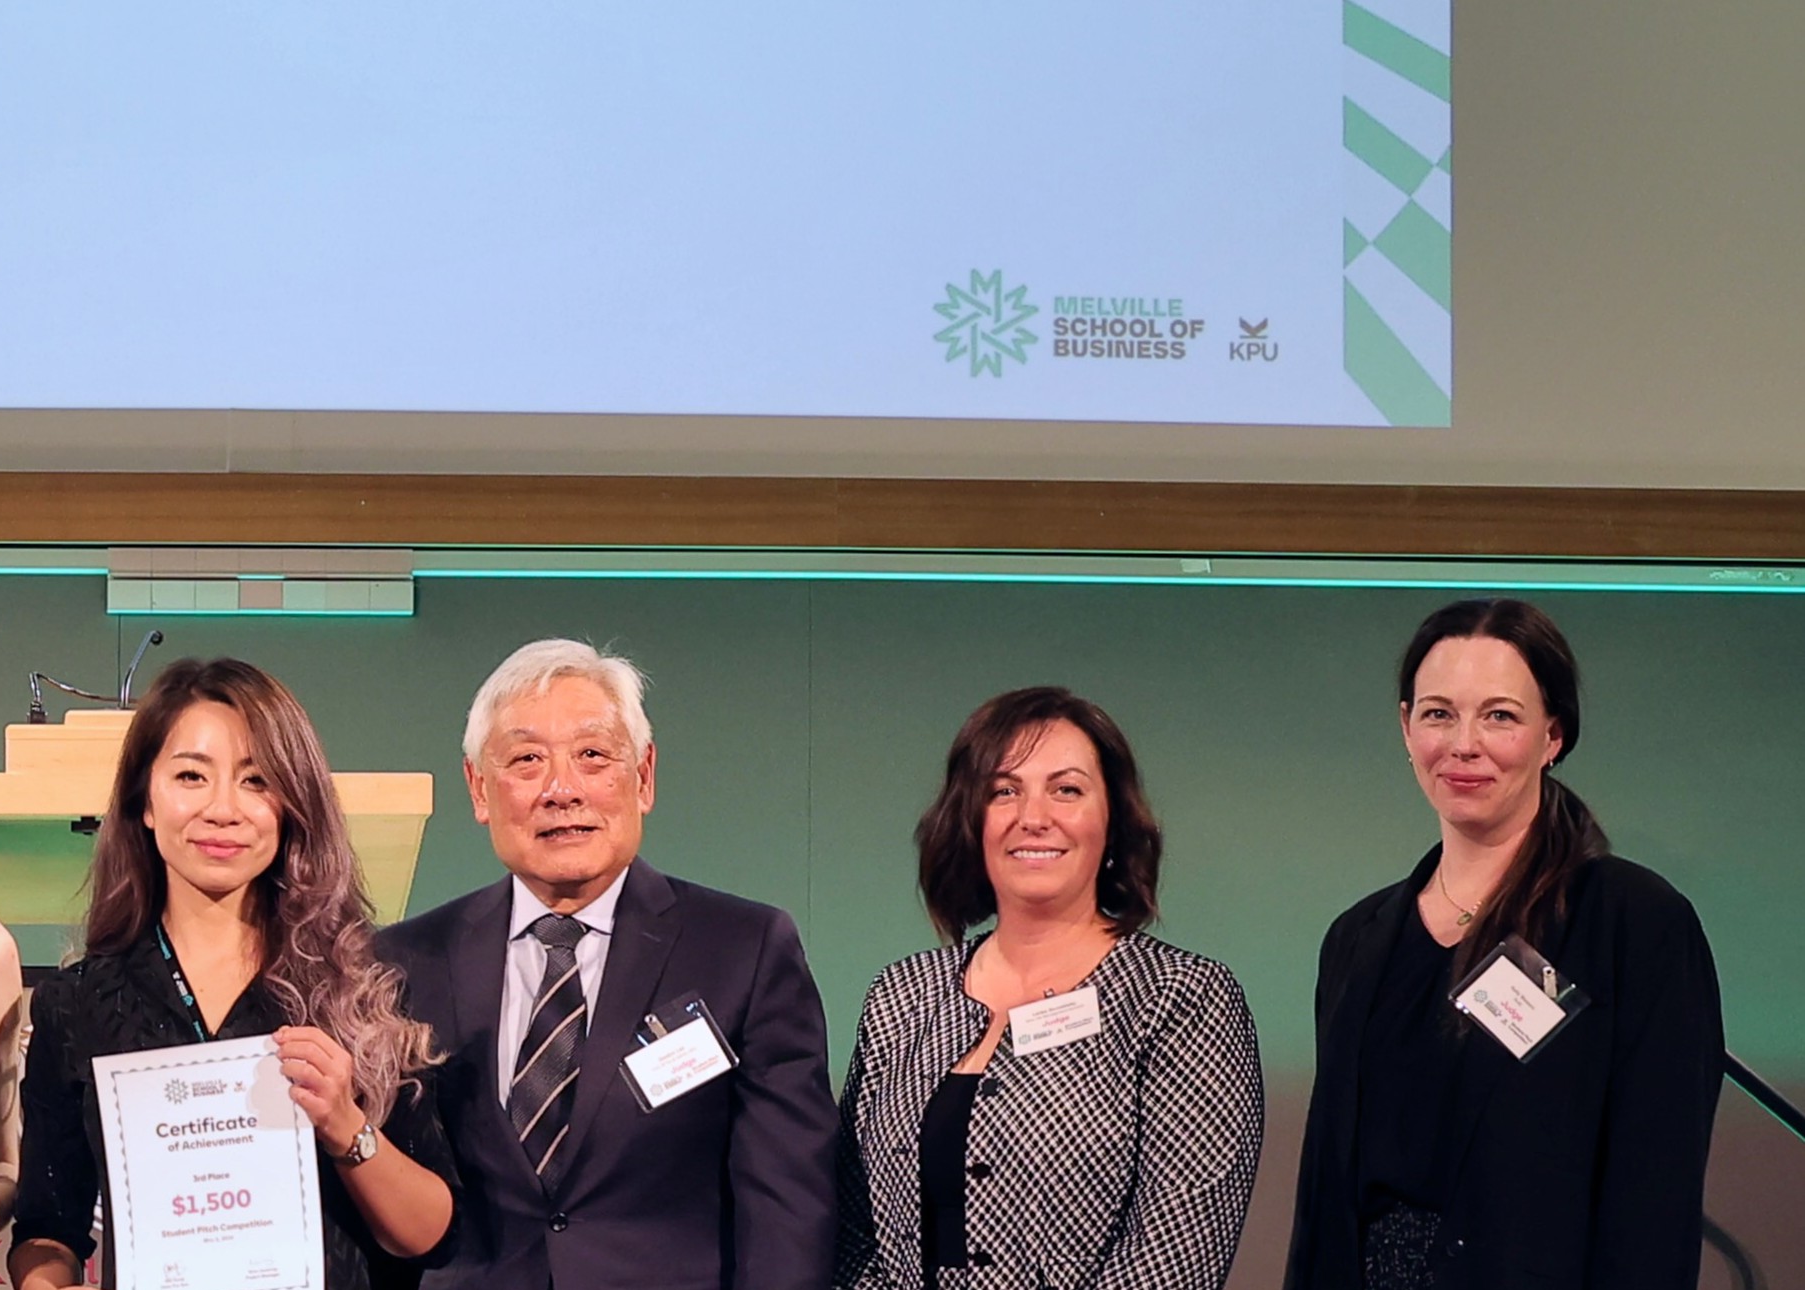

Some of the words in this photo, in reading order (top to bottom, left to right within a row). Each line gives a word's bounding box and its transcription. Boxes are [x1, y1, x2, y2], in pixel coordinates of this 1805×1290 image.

[1053, 296, 1184, 317] MELVILLE
[1053, 317, 1164, 338] SCHOOL
[1169, 319, 1206, 339] OF
[1053, 338, 1187, 360] BUSINESS
[1228, 342, 1280, 362] KPU
[156, 1116, 257, 1138] Certificate
[168, 1141, 179, 1152] of
[182, 1134, 254, 1151] Achievement
[208, 1172, 230, 1181] Place
[172, 1189, 251, 1217] $1,500
[162, 1229, 195, 1238] Student
[197, 1225, 219, 1234] Pitch
[220, 1219, 273, 1232] Competition
